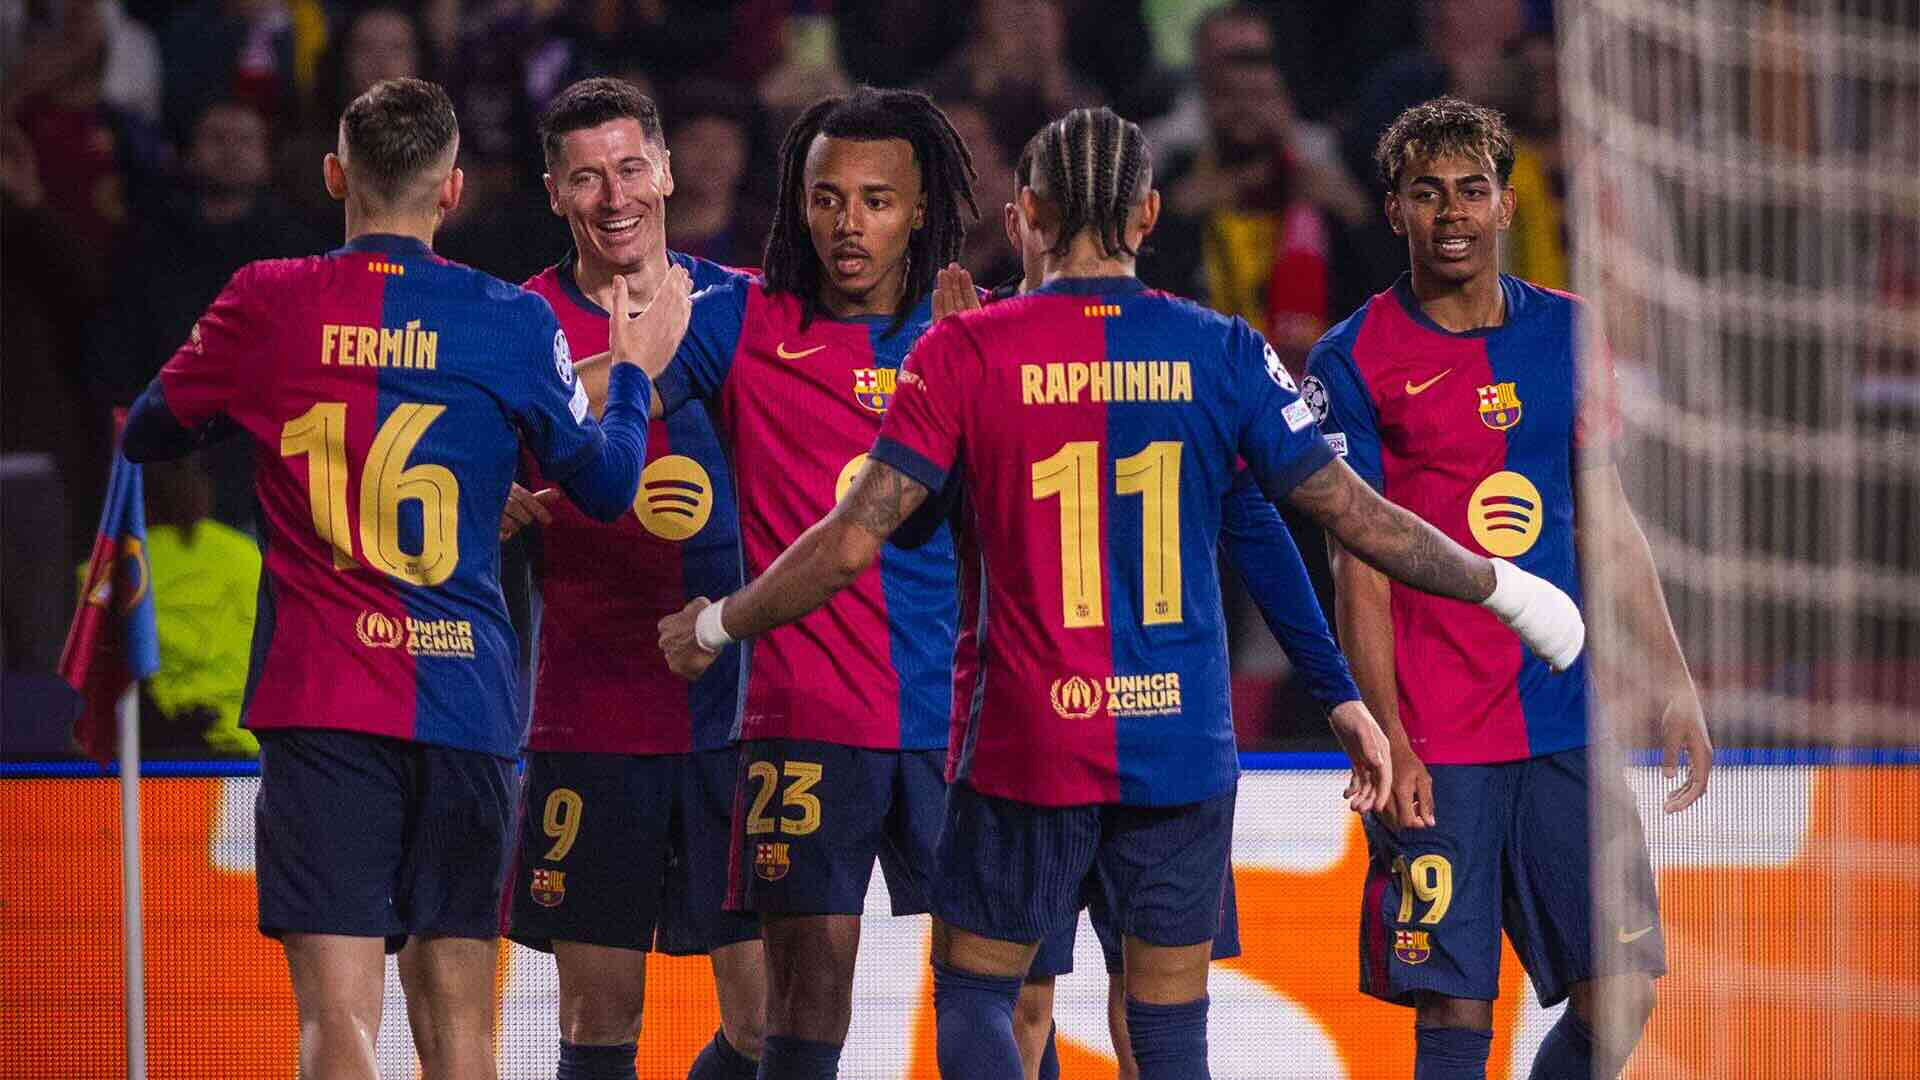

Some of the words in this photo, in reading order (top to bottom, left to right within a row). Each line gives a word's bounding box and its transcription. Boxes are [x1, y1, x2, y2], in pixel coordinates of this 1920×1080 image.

[321, 319, 438, 370] FERMÍN
[1021, 361, 1192, 404] RAPHINHA
[281, 402, 460, 586] 16
[1032, 441, 1184, 628] 11
[405, 616, 472, 637] UNHCR
[406, 632, 475, 651] ACNUR
[1105, 672, 1180, 693] UNHCR
[1106, 690, 1181, 709] ACNUR
[746, 760, 823, 836] 23
[543, 788, 583, 861] 9
[1391, 854, 1453, 923] 19
